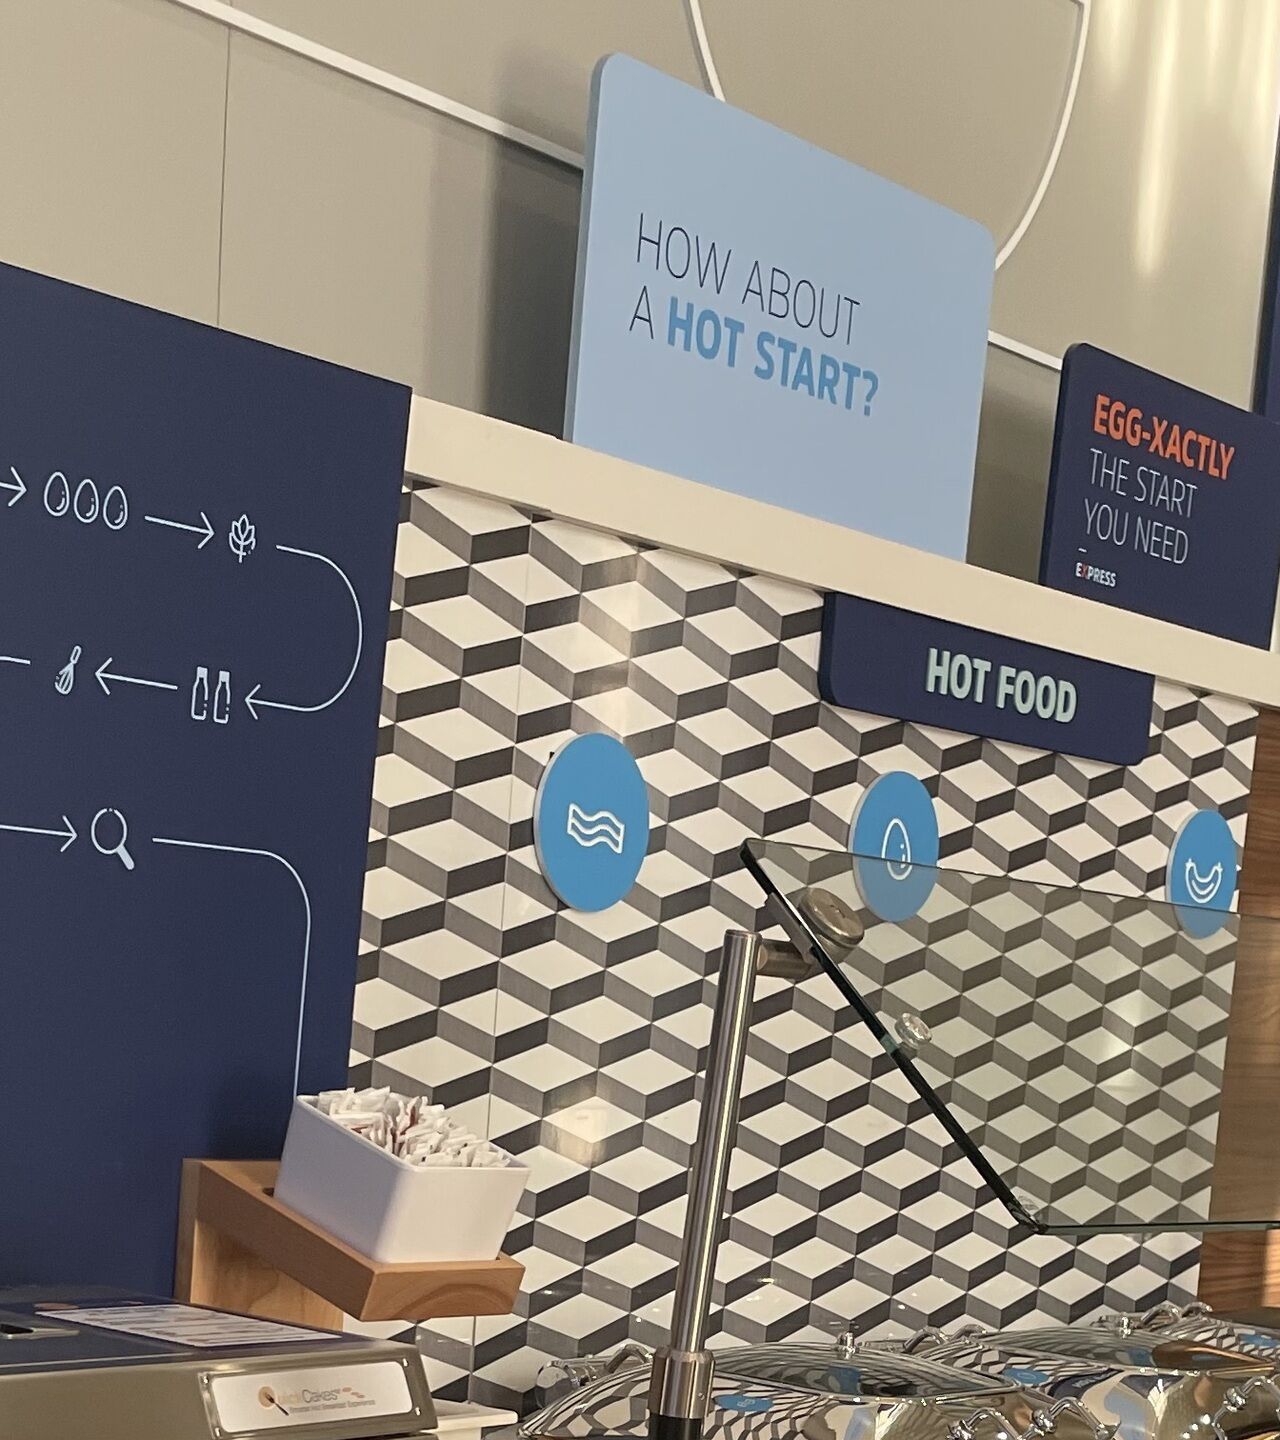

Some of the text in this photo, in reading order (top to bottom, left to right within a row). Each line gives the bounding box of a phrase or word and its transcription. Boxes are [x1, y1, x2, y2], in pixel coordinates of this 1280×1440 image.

[637, 212, 860, 345] HOW ABOUT
[629, 285, 879, 416] A HOT START?
[1093, 393, 1235, 480] EGG-XACTLY
[1090, 448, 1198, 518] THE START
[1084, 498, 1189, 564] YOU NEED
[1075, 562, 1117, 587] EXPRESS
[926, 648, 1077, 723] HOT FOOD
